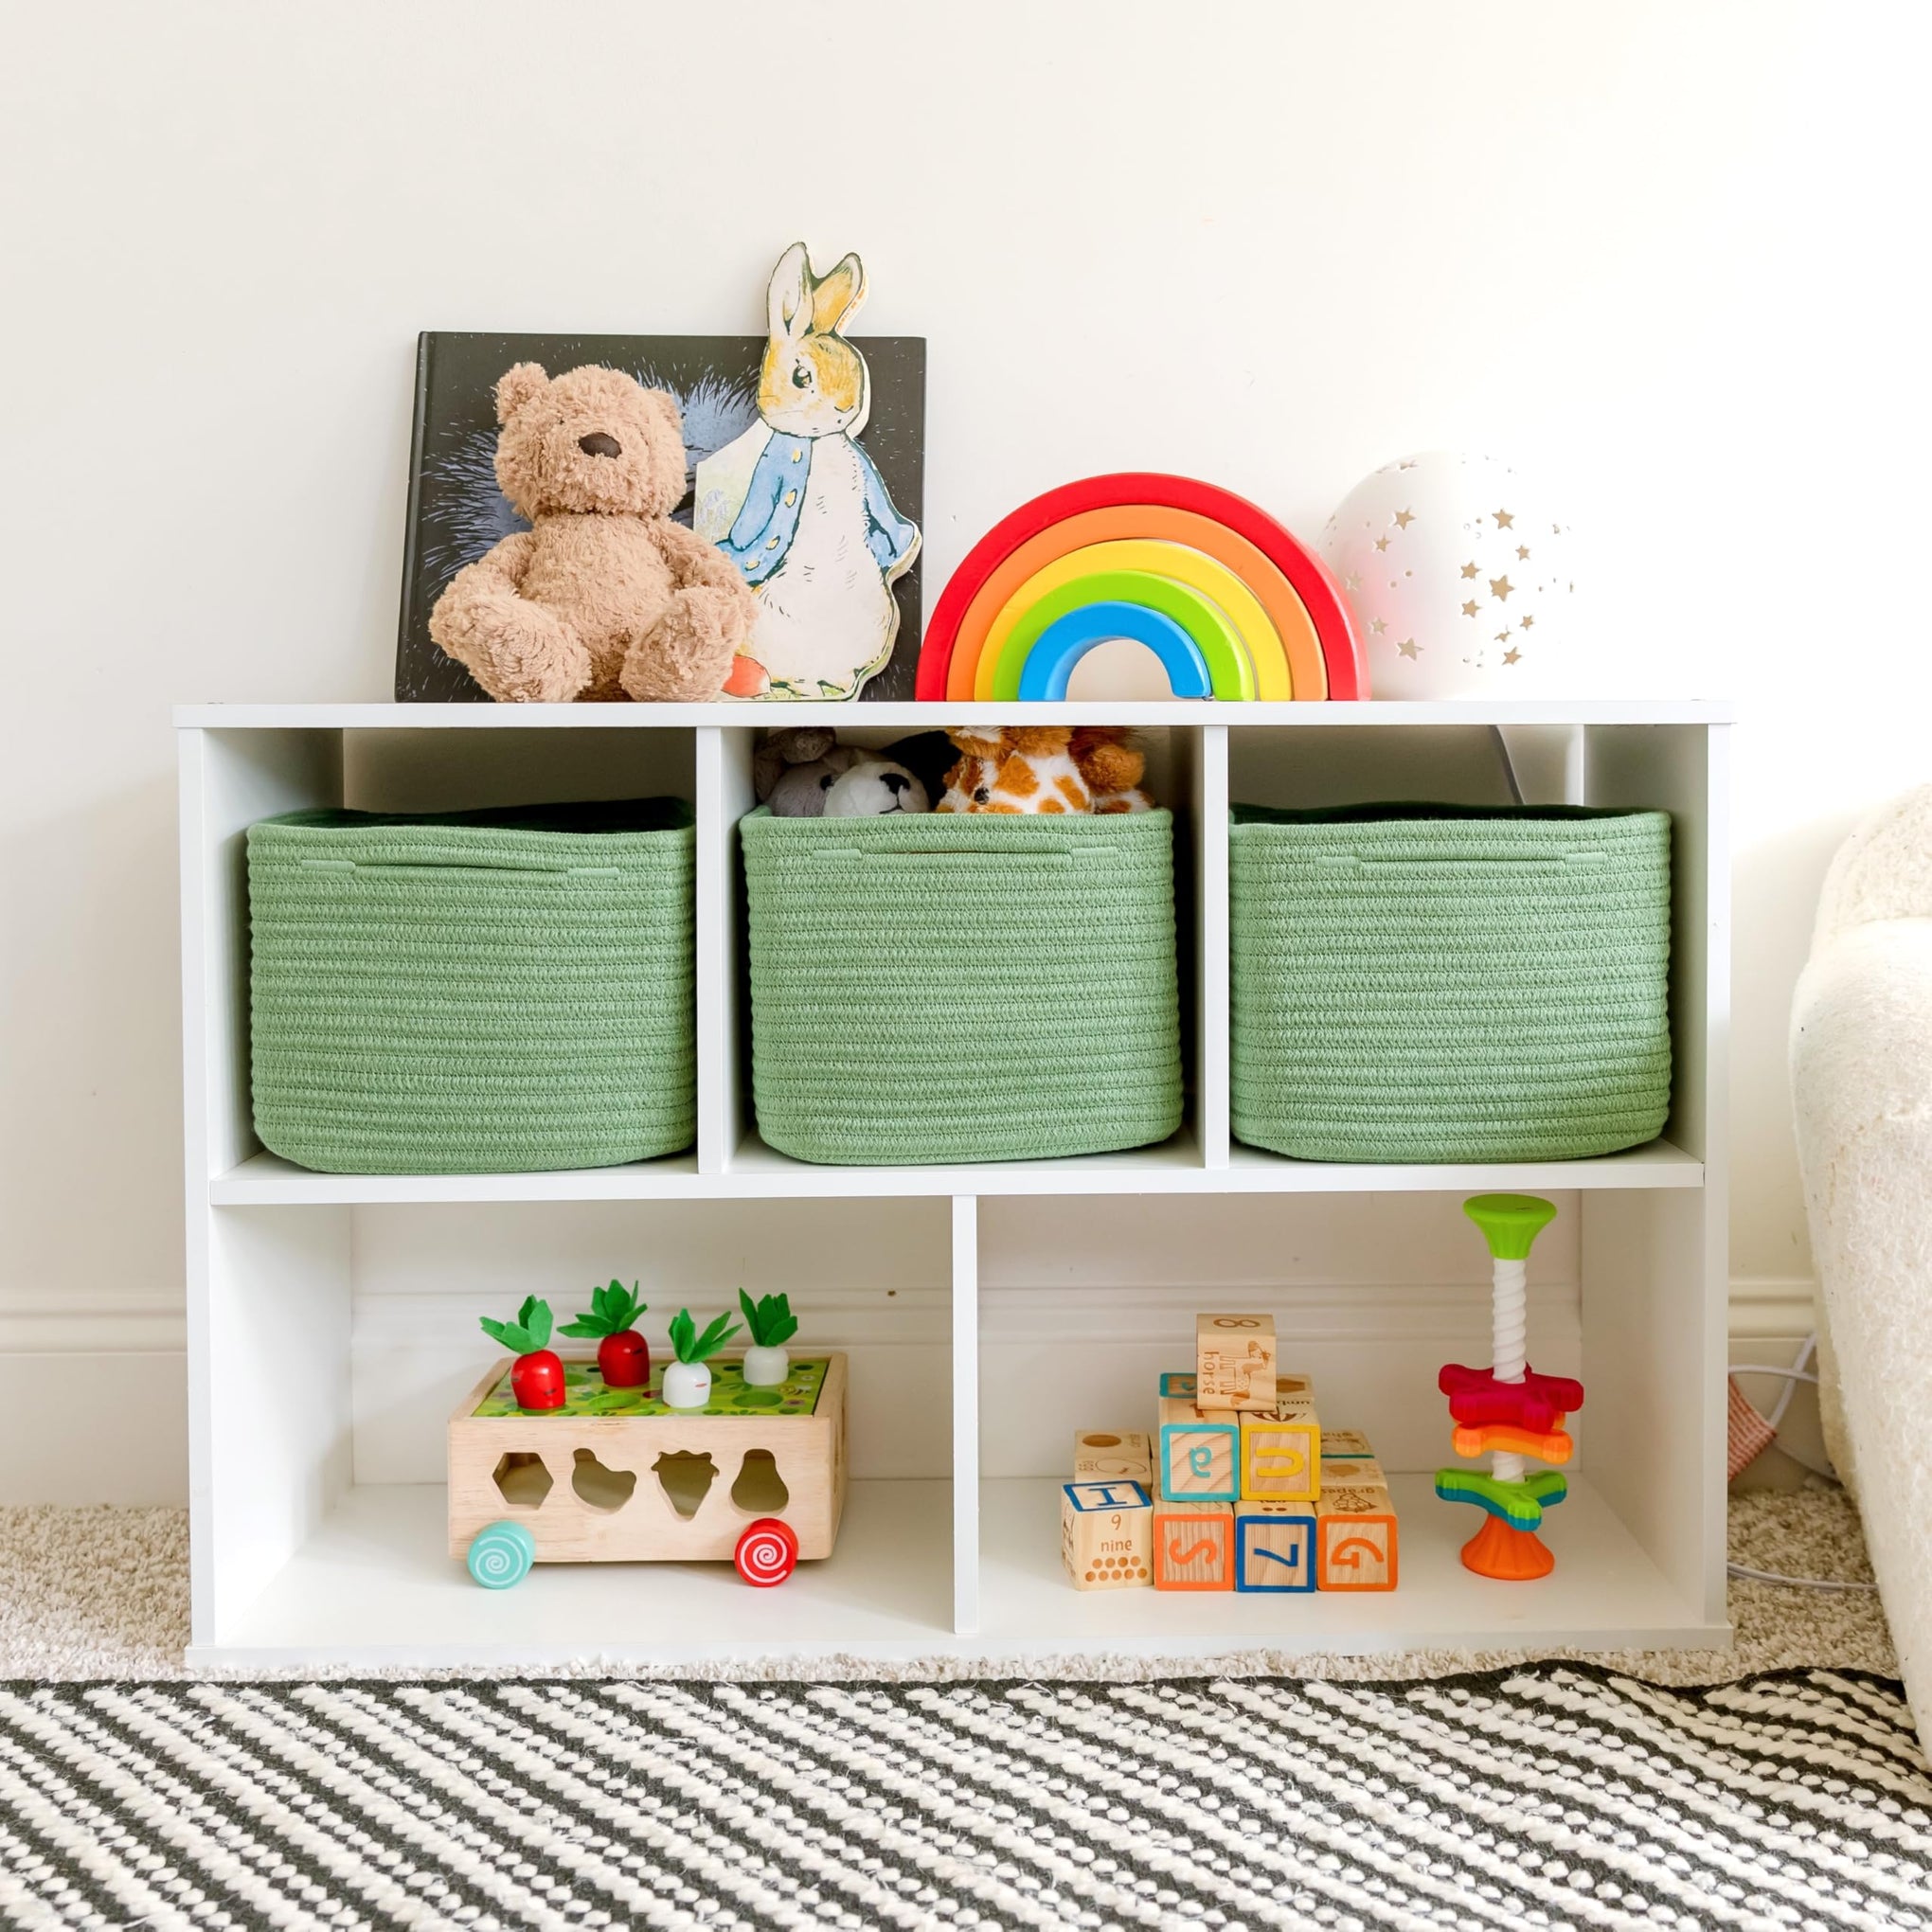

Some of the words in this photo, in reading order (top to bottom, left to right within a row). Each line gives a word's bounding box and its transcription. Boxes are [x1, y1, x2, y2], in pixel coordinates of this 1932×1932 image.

[1213, 1318, 1261, 1328] 8
[1203, 1351, 1220, 1394] horse
[1111, 1514, 1121, 1530] 9
[1101, 1540, 1133, 1551] nine
[1332, 1537, 1385, 1569] G
